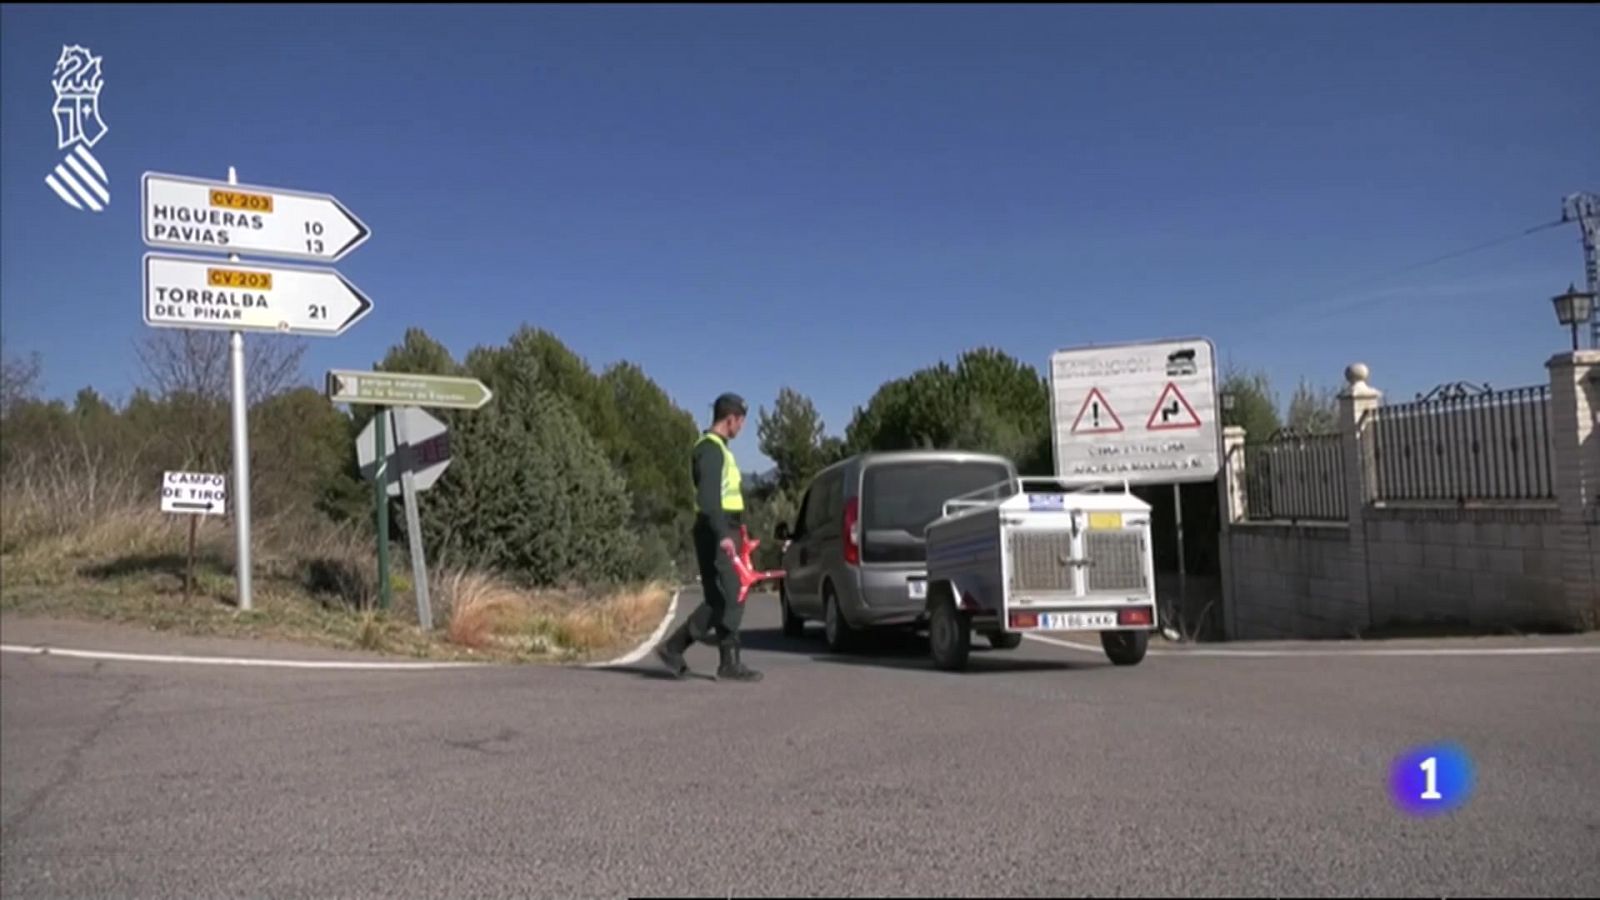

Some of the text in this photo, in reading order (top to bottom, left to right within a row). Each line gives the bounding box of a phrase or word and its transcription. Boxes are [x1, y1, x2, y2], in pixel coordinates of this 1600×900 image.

[153, 204, 324, 236] HIGUERAS 10
[153, 224, 324, 254] PAVIAS 13
[155, 287, 269, 309] TORRALBA
[154, 304, 328, 320] DEL PINAR 21
[168, 472, 223, 487] CAMPO
[163, 487, 225, 502] DE TIRO
